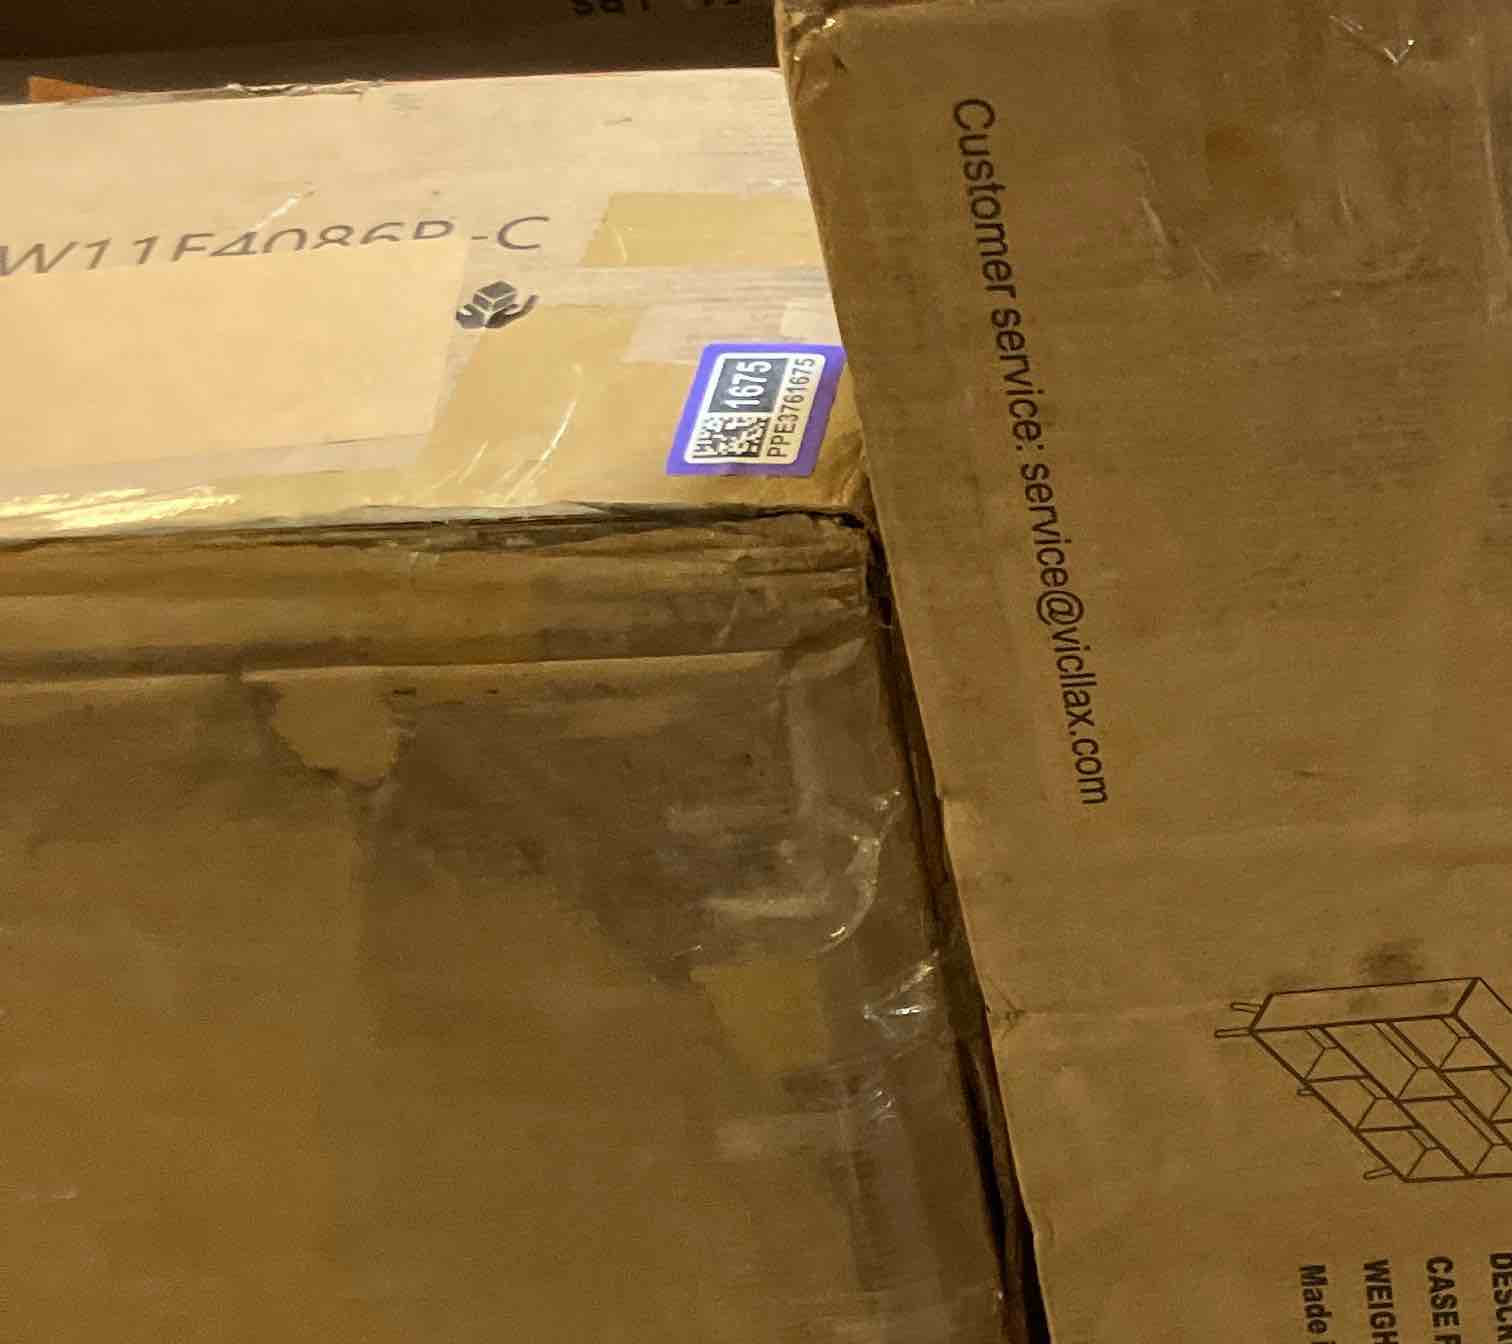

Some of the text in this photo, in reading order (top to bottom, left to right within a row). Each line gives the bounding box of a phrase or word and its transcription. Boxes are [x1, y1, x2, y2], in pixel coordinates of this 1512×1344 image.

[953, 98, 1018, 299] Customer
[991, 306, 1043, 452] service:
[728, 360, 772, 410] 1675
[765, 358, 816, 459] PPE3761675
[1300, 1264, 1332, 1335] Made
[1425, 1256, 1461, 1327] CASE
